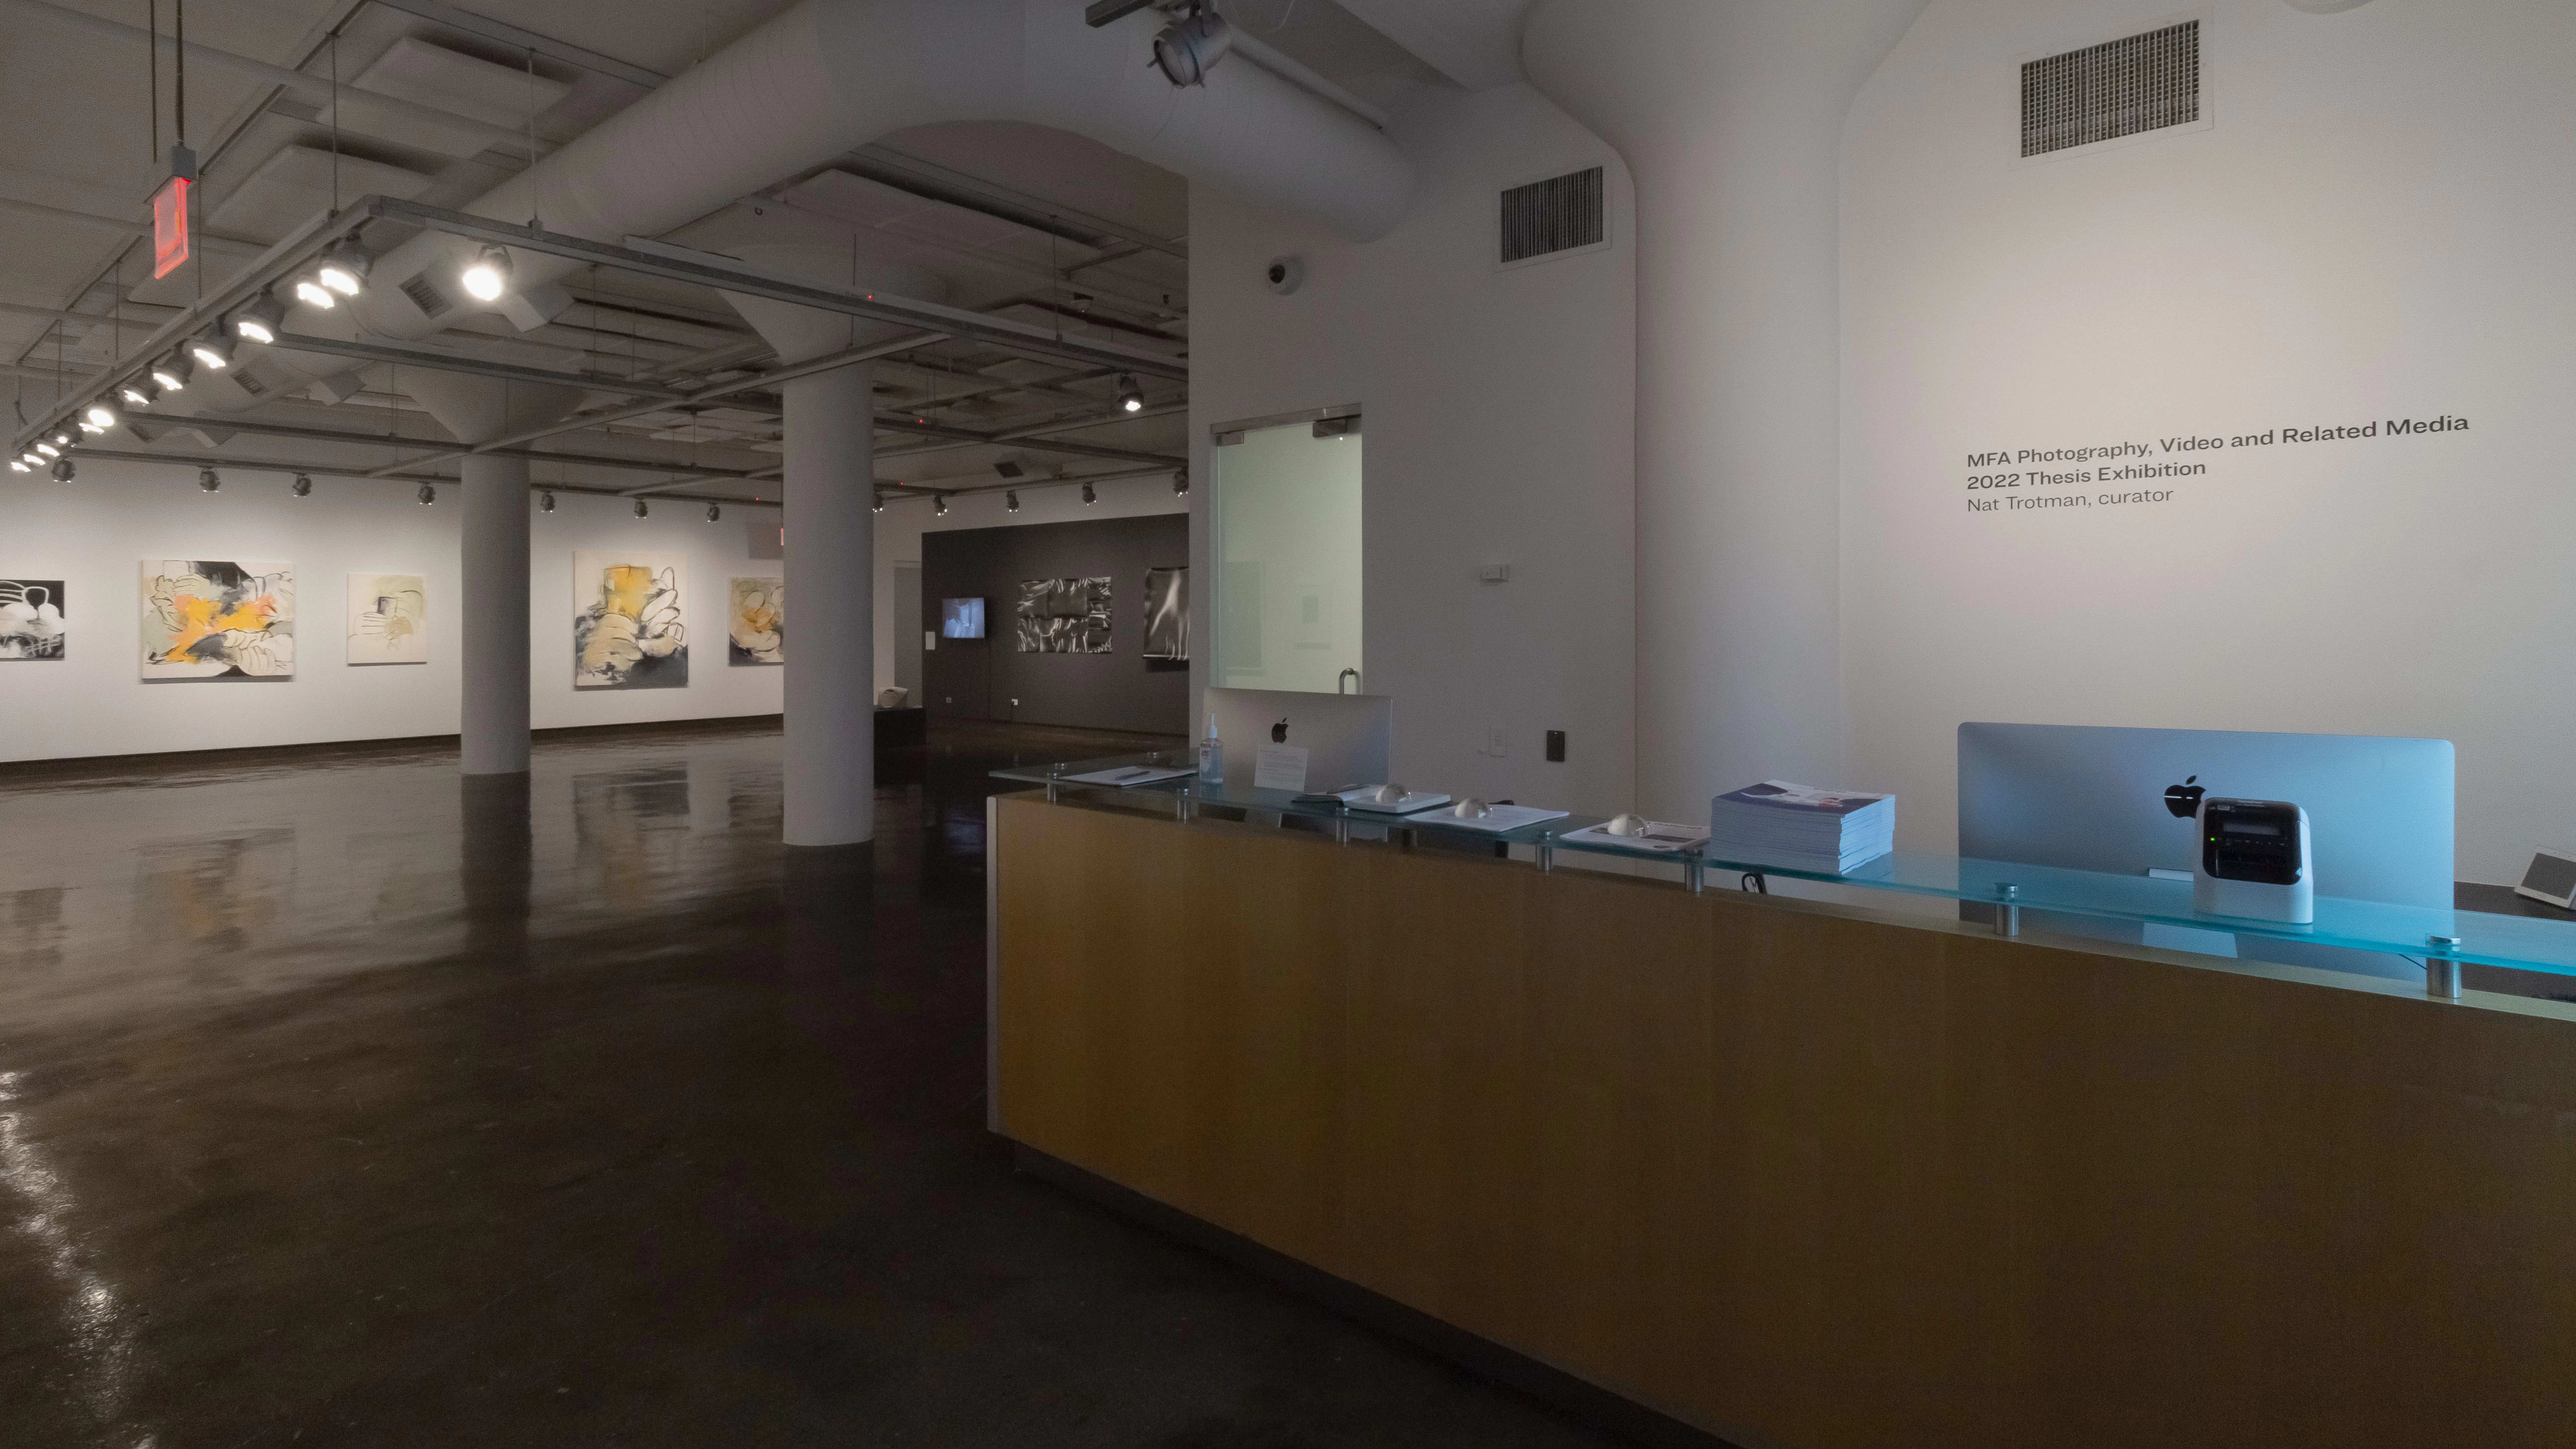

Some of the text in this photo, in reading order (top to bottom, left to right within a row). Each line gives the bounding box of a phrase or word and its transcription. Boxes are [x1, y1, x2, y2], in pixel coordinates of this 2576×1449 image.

[1967, 415, 2470, 468] MFA Photography, Video and Related Media
[1967, 462, 2206, 490] 2022 Thesis Exhibition
[1968, 489, 2174, 512] Nat Trotman, curator
